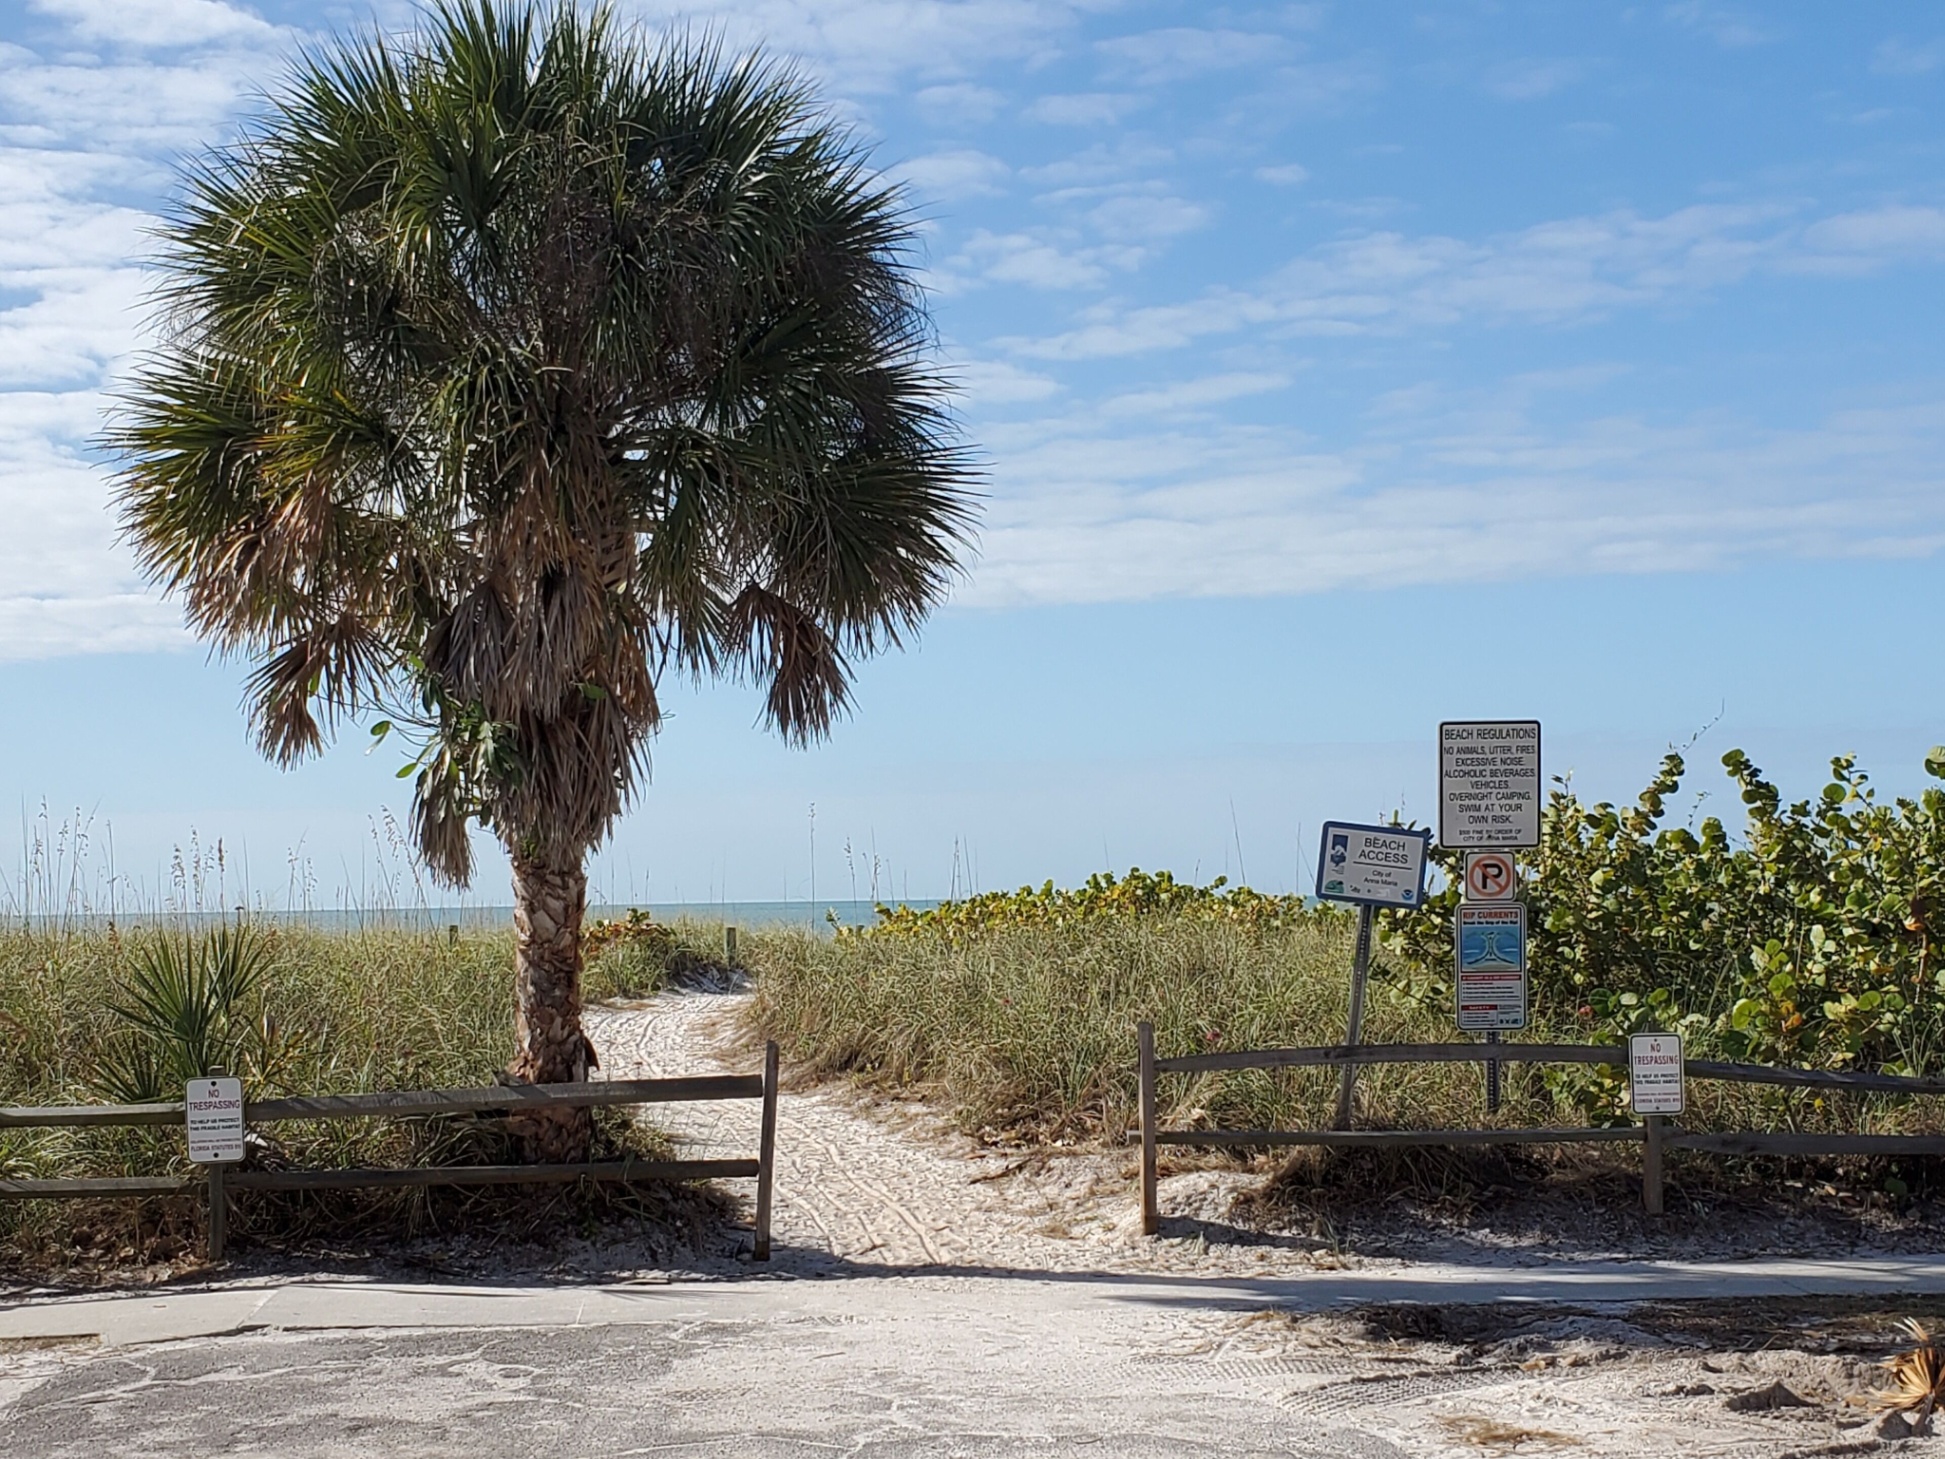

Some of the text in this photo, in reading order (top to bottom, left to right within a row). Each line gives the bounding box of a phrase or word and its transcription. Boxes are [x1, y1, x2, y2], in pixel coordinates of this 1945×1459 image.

[1445, 728, 1536, 740] BEACH REGULATIONS
[1444, 747, 1454, 755] NO
[1455, 758, 1498, 766] EXCESSIVE
[1444, 770, 1486, 778] ALCOHOLIC
[1449, 793, 1493, 801] OVERNIGHT
[1458, 803, 1523, 813] SWIM AT YOUR
[1468, 816, 1488, 824] OWN
[1364, 837, 1406, 851] BEACH
[1358, 850, 1408, 864] ACCESS
[1650, 1043, 1661, 1053] NO
[1634, 1055, 1679, 1065] TRESPASSING
[208, 1090, 220, 1098] NO
[189, 1100, 240, 1111] TRESPASSING
